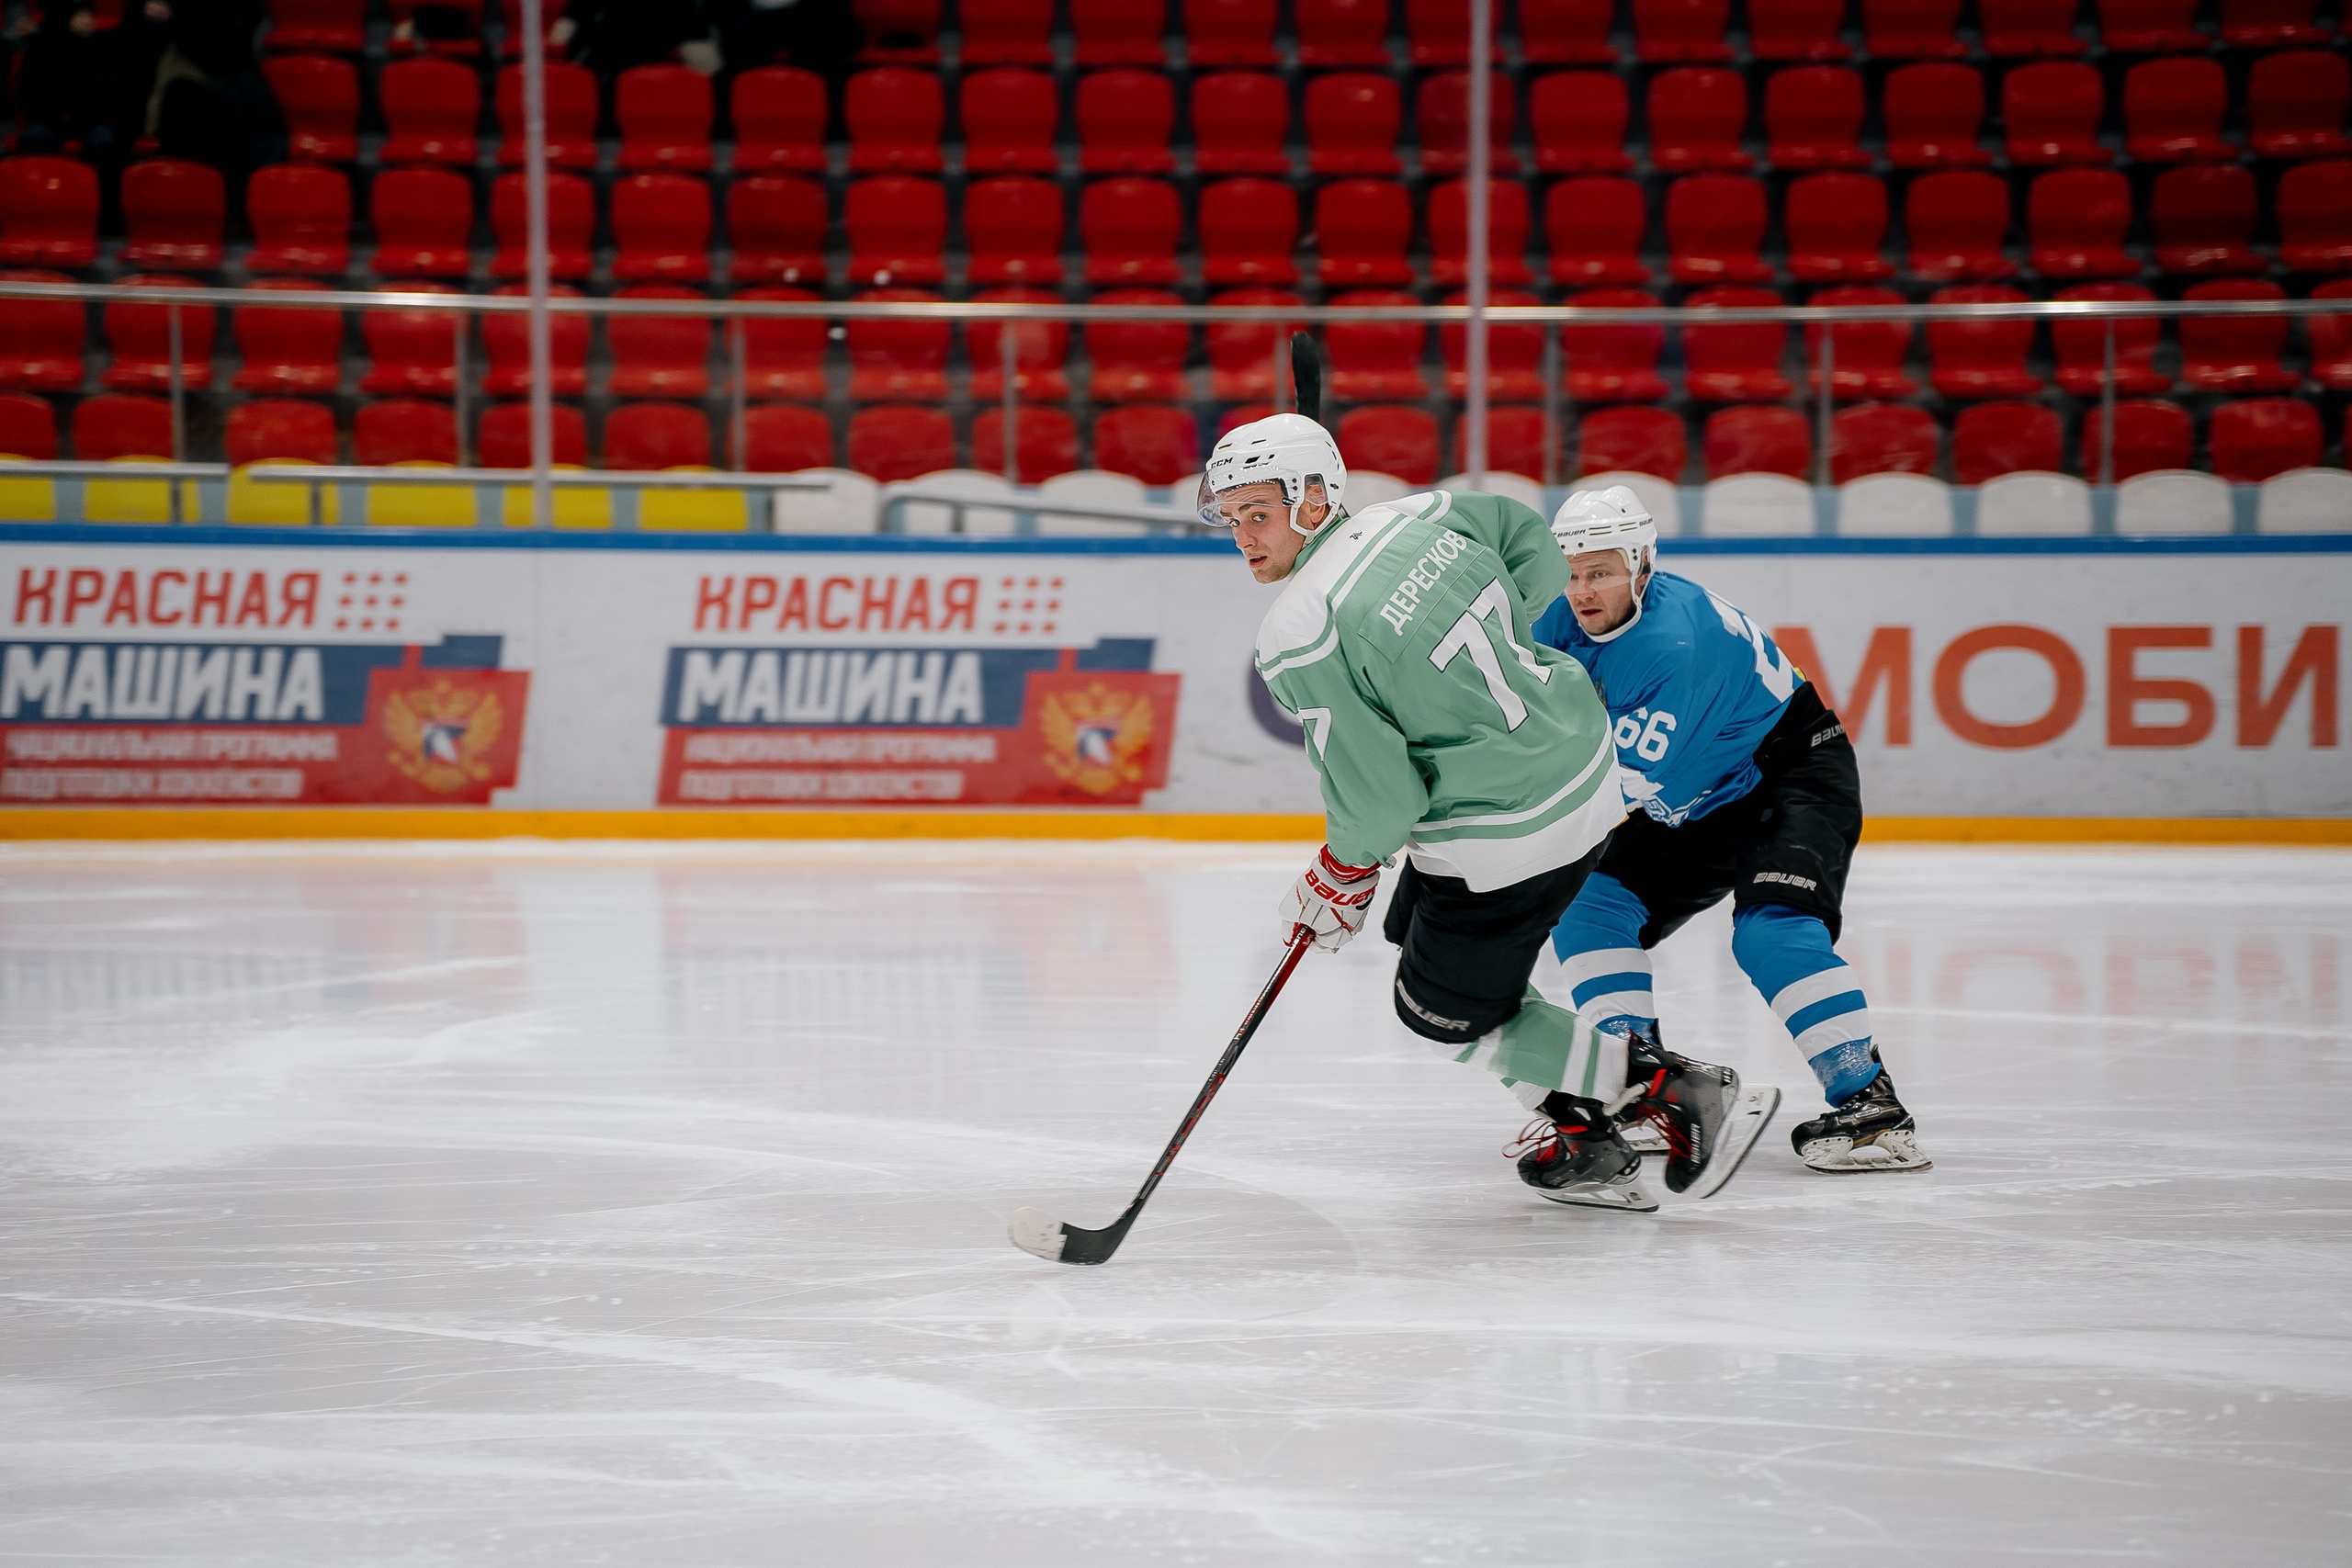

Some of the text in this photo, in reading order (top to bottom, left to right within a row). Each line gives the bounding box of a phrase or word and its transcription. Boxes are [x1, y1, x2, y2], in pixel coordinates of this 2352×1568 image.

[12, 568, 321, 627] КРАСНАЯ
[693, 575, 980, 632] КРАСНАЯ
[1378, 529, 1467, 637] ДЕРЕСКОВ
[0, 646, 324, 722] МАШИНА
[677, 650, 984, 723] МАШИНА
[1427, 575, 1554, 734] 77
[1772, 623, 2340, 750] МОБИ
[1613, 706, 1677, 761] 66
[1753, 872, 1817, 891] BAUER
